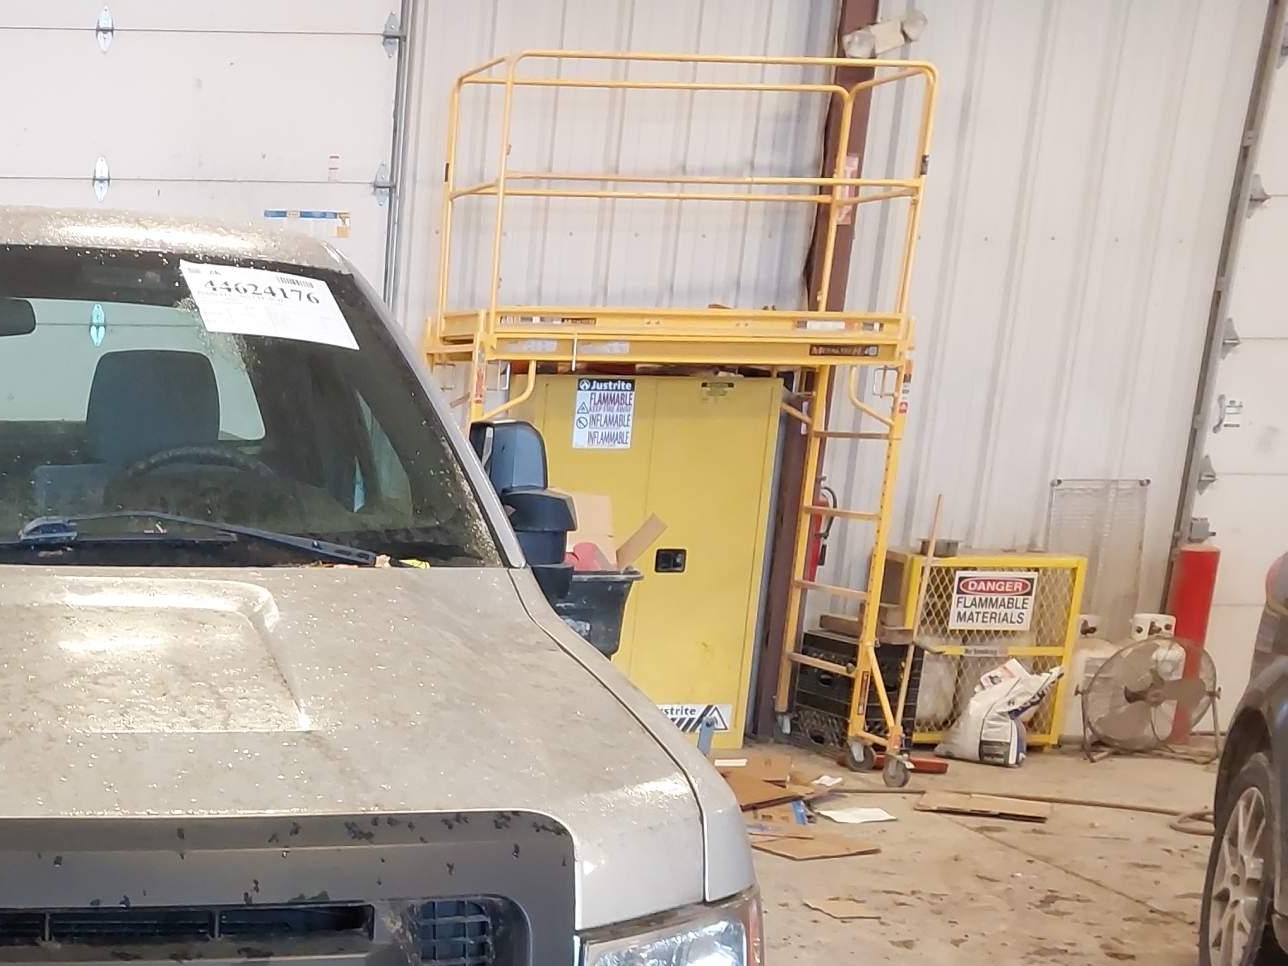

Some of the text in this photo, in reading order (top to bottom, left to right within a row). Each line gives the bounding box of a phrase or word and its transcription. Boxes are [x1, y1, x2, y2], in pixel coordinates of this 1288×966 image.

[204, 280, 320, 305] 44624176
[591, 380, 632, 391] Justrite
[590, 392, 633, 406] FLAMMABLE
[589, 413, 631, 427] INFLAMABLE
[967, 580, 1023, 592] DANGER
[956, 597, 1029, 610] FLAMMABLE
[956, 611, 1025, 625] MATERIALS
[661, 706, 696, 716] strite
